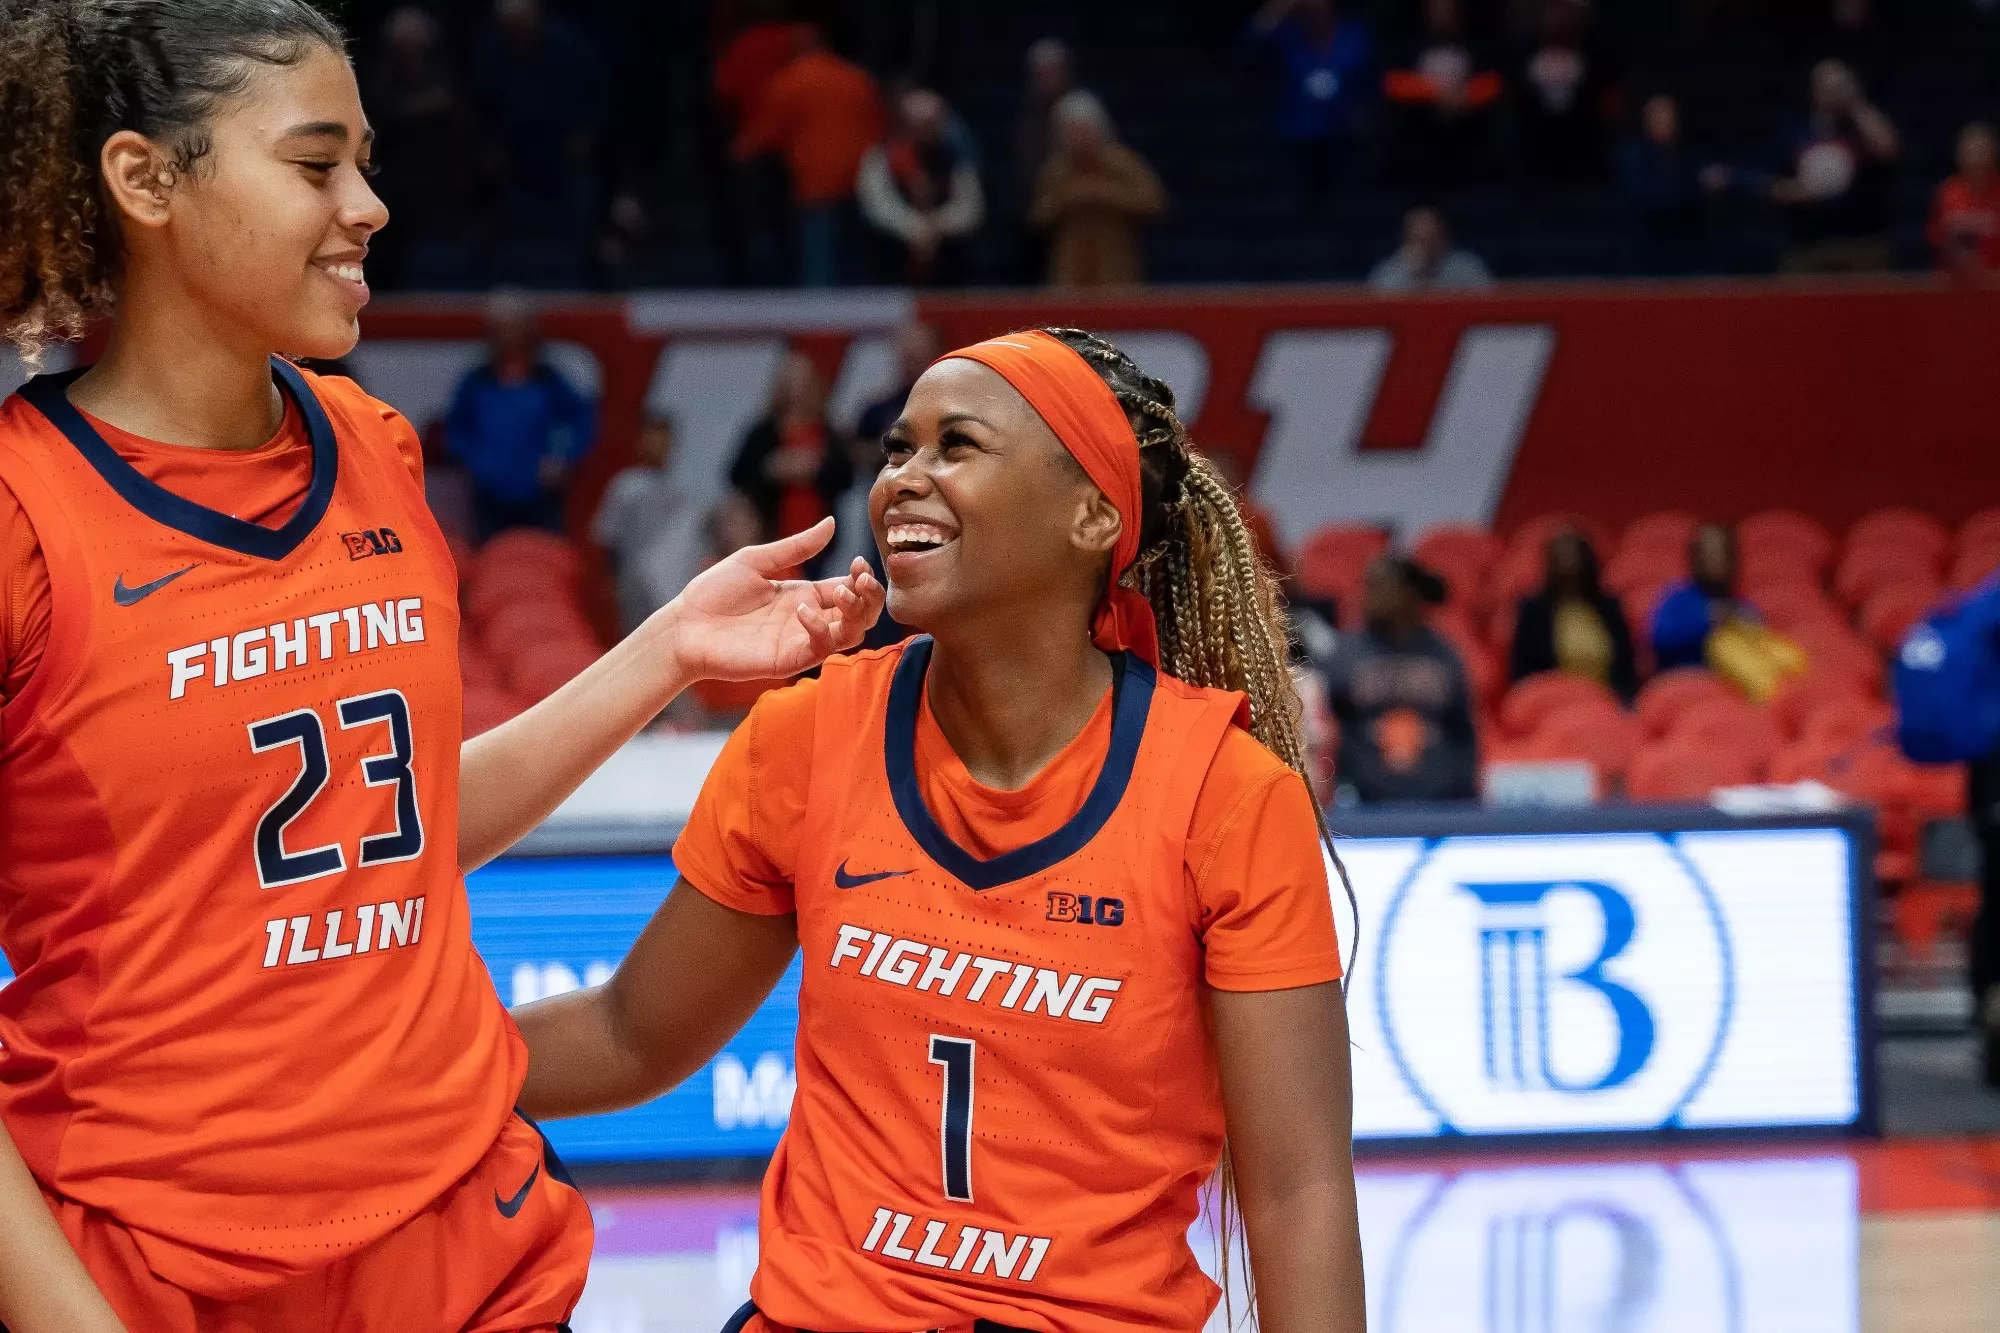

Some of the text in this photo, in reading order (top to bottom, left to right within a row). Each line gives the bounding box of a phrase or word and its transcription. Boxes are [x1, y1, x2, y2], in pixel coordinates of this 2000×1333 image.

[167, 597, 425, 700] FIGHTING
[246, 688, 425, 889] 23
[262, 896, 425, 968] ILLINI
[829, 923, 1123, 1024] FIGHTING
[928, 1033, 975, 1203] 1
[861, 1207, 1051, 1282] ILLINI
